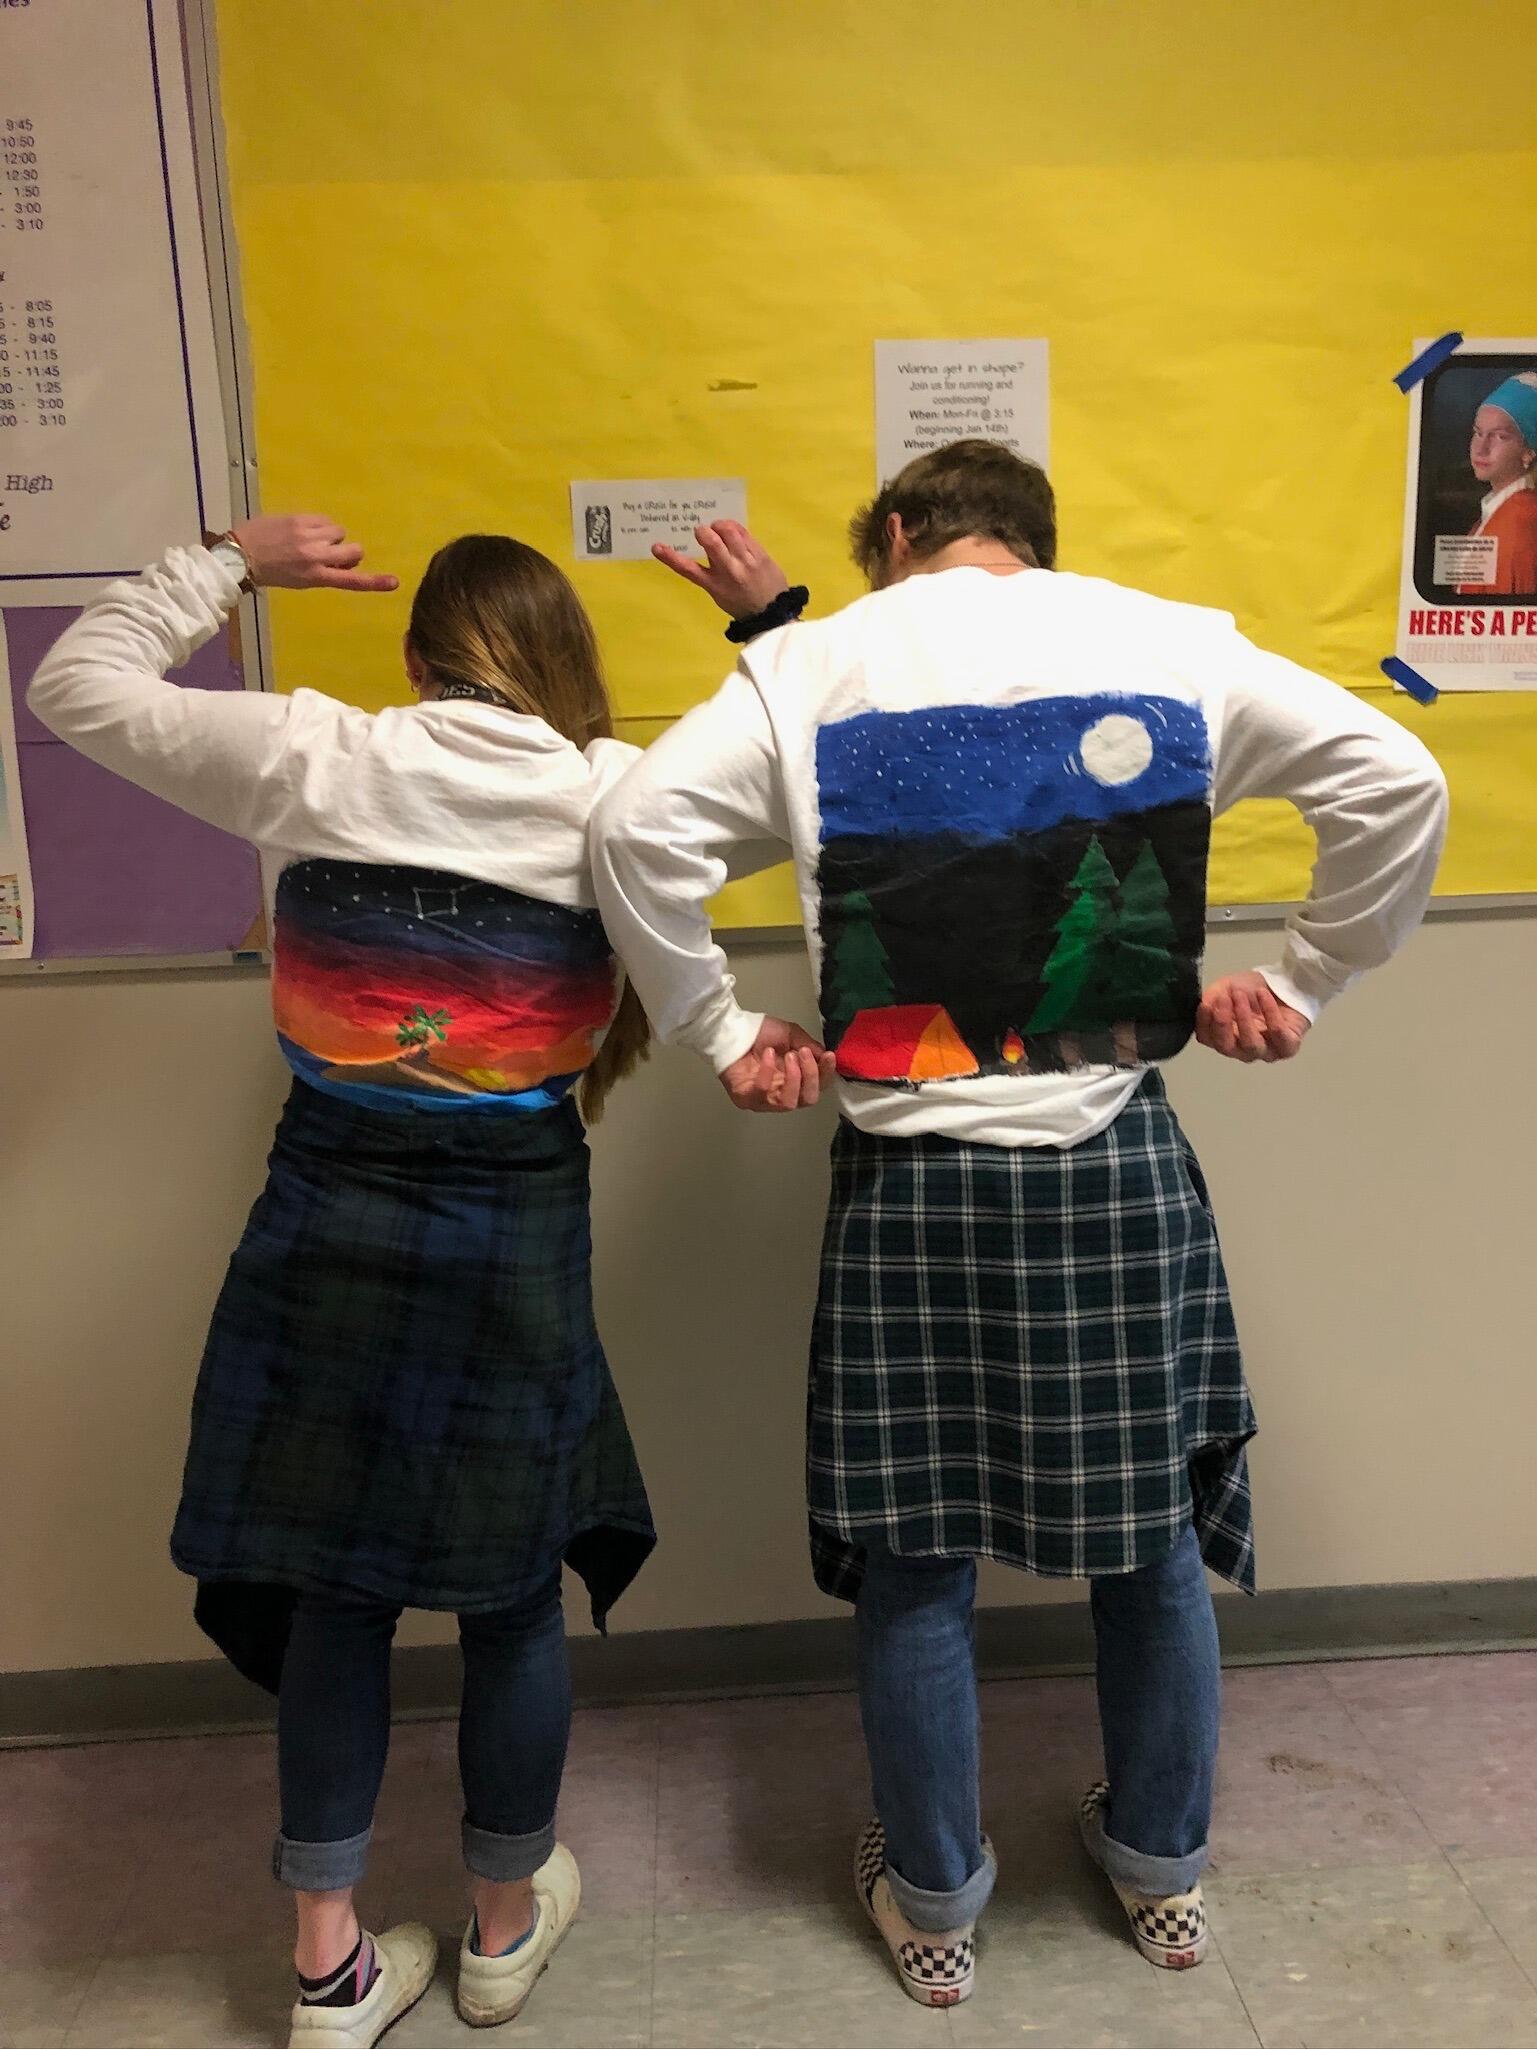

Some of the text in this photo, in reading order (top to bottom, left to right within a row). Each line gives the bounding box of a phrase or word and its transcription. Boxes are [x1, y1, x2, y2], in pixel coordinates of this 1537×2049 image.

[15, 202, 42, 214] 3:00
[897, 362, 938, 375] Wanna
[943, 363, 962, 378] get
[982, 361, 1025, 378] shape?
[910, 379, 1013, 392] Join us for running and
[37, 398, 64, 410] 3:00
[932, 395, 990, 406] conditioning!
[909, 409, 939, 421] When:
[943, 409, 978, 419] Mon-Fri
[994, 408, 1014, 418] 3:15
[915, 424, 963, 436] (beginning
[904, 439, 937, 450] Where:
[4, 474, 54, 495] High
[1409, 610, 1486, 636] HERE'S
[1490, 610, 1506, 636] A
